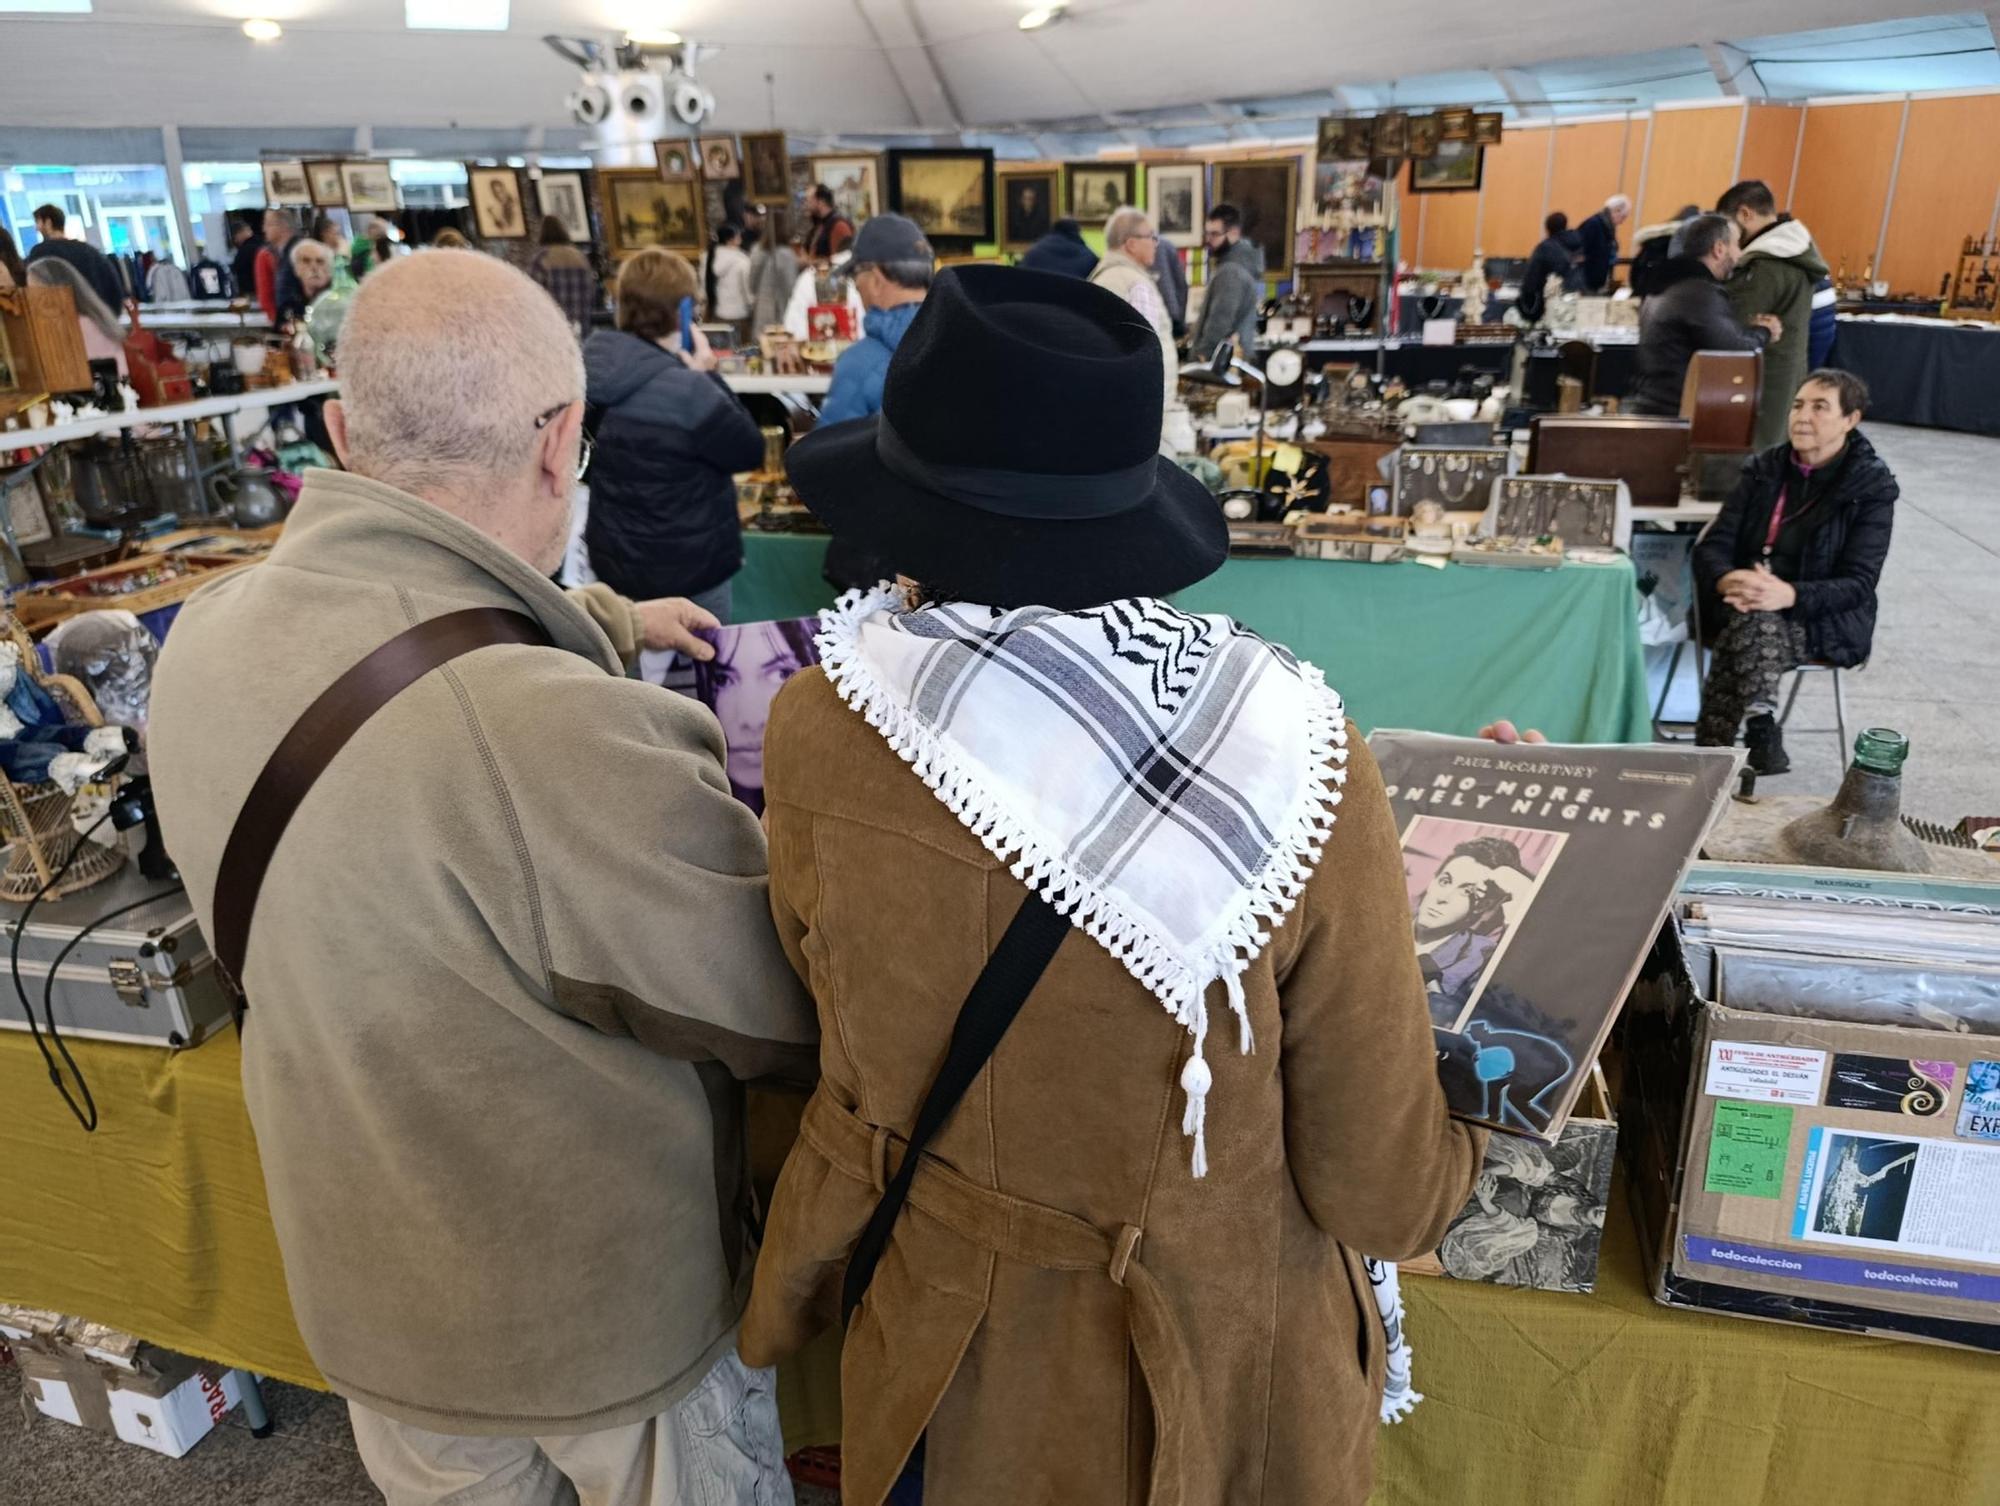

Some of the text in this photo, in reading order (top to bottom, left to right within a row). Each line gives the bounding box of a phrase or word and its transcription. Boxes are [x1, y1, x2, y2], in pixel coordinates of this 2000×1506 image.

[1453, 755, 1598, 779] PAUL McCARTNEY
[1432, 774, 1594, 804] NO MORE
[1386, 785, 1667, 829] ONELY NIGHTS
[1711, 1247, 1803, 1272] todocoleccion
[1864, 1268, 1959, 1290] todocoleccion
